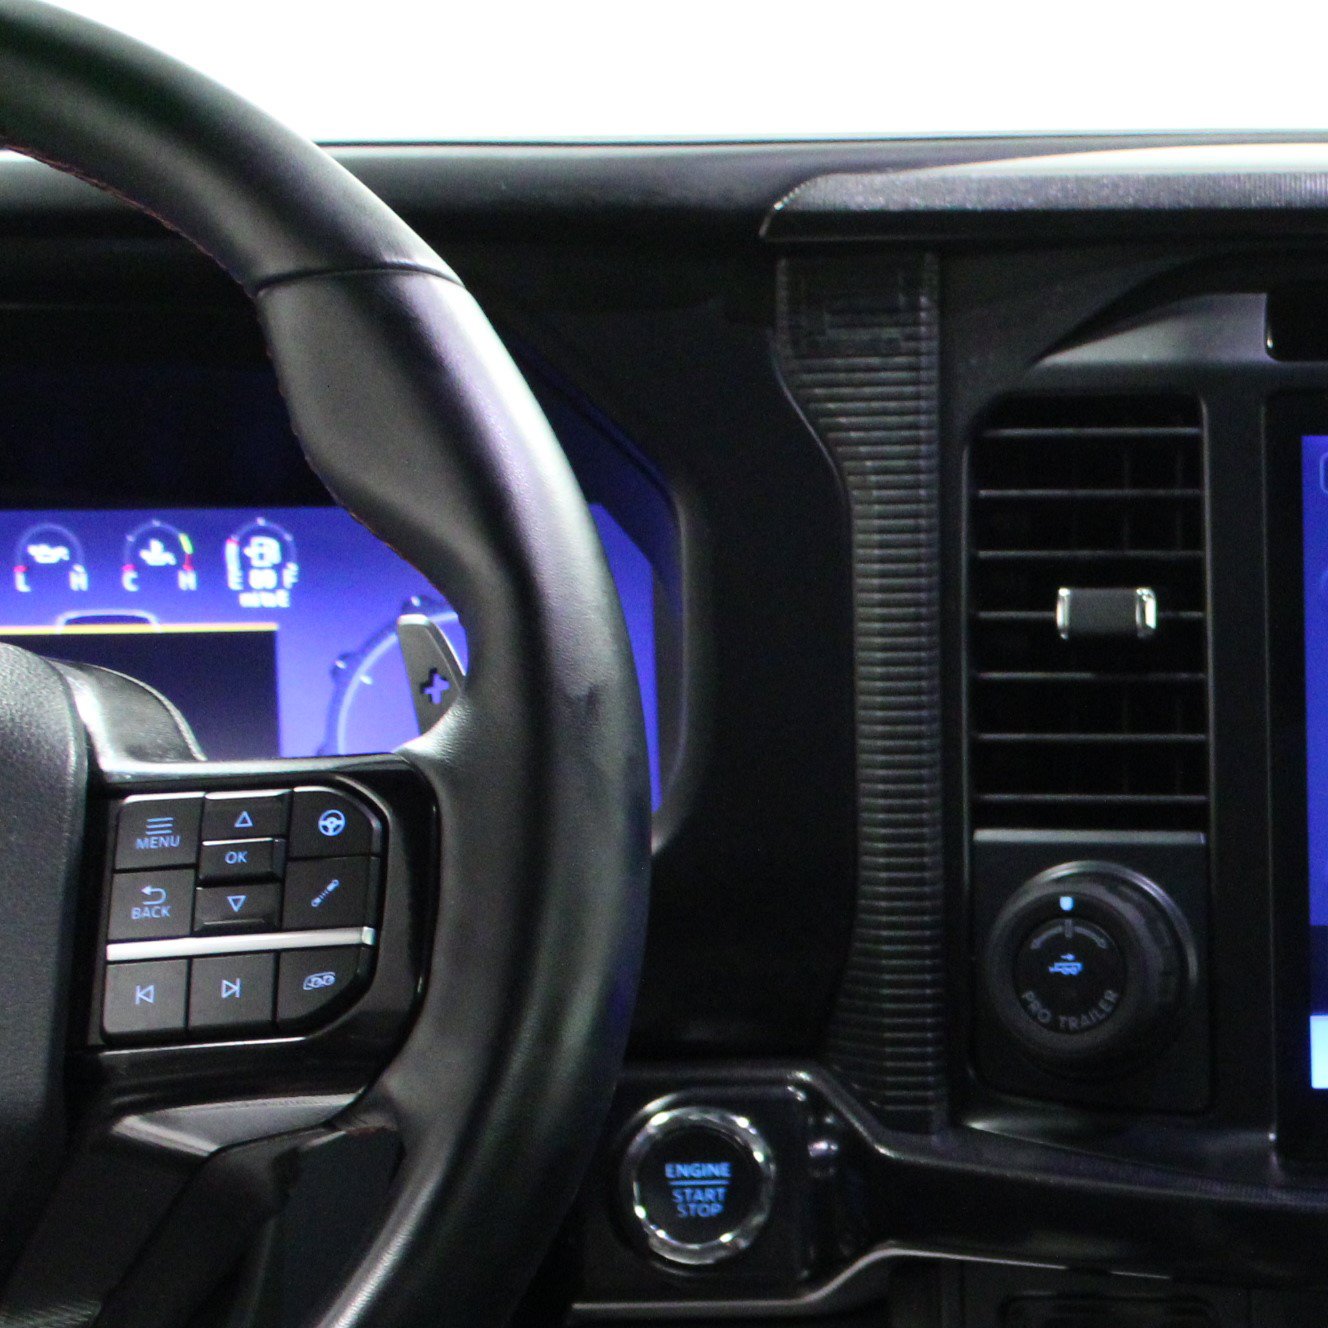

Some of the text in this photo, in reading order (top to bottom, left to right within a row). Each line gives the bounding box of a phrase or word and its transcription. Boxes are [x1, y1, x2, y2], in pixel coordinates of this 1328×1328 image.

[15, 571, 31, 592] L
[121, 570, 139, 591] C
[177, 570, 197, 591] H
[136, 835, 181, 849] MENU
[225, 851, 247, 864] OK
[131, 906, 171, 919] BACK
[1059, 989, 1119, 1030] TRAILER
[664, 1162, 731, 1178] ENGINE
[672, 1188, 726, 1202] START
[677, 1203, 723, 1217] STOP
